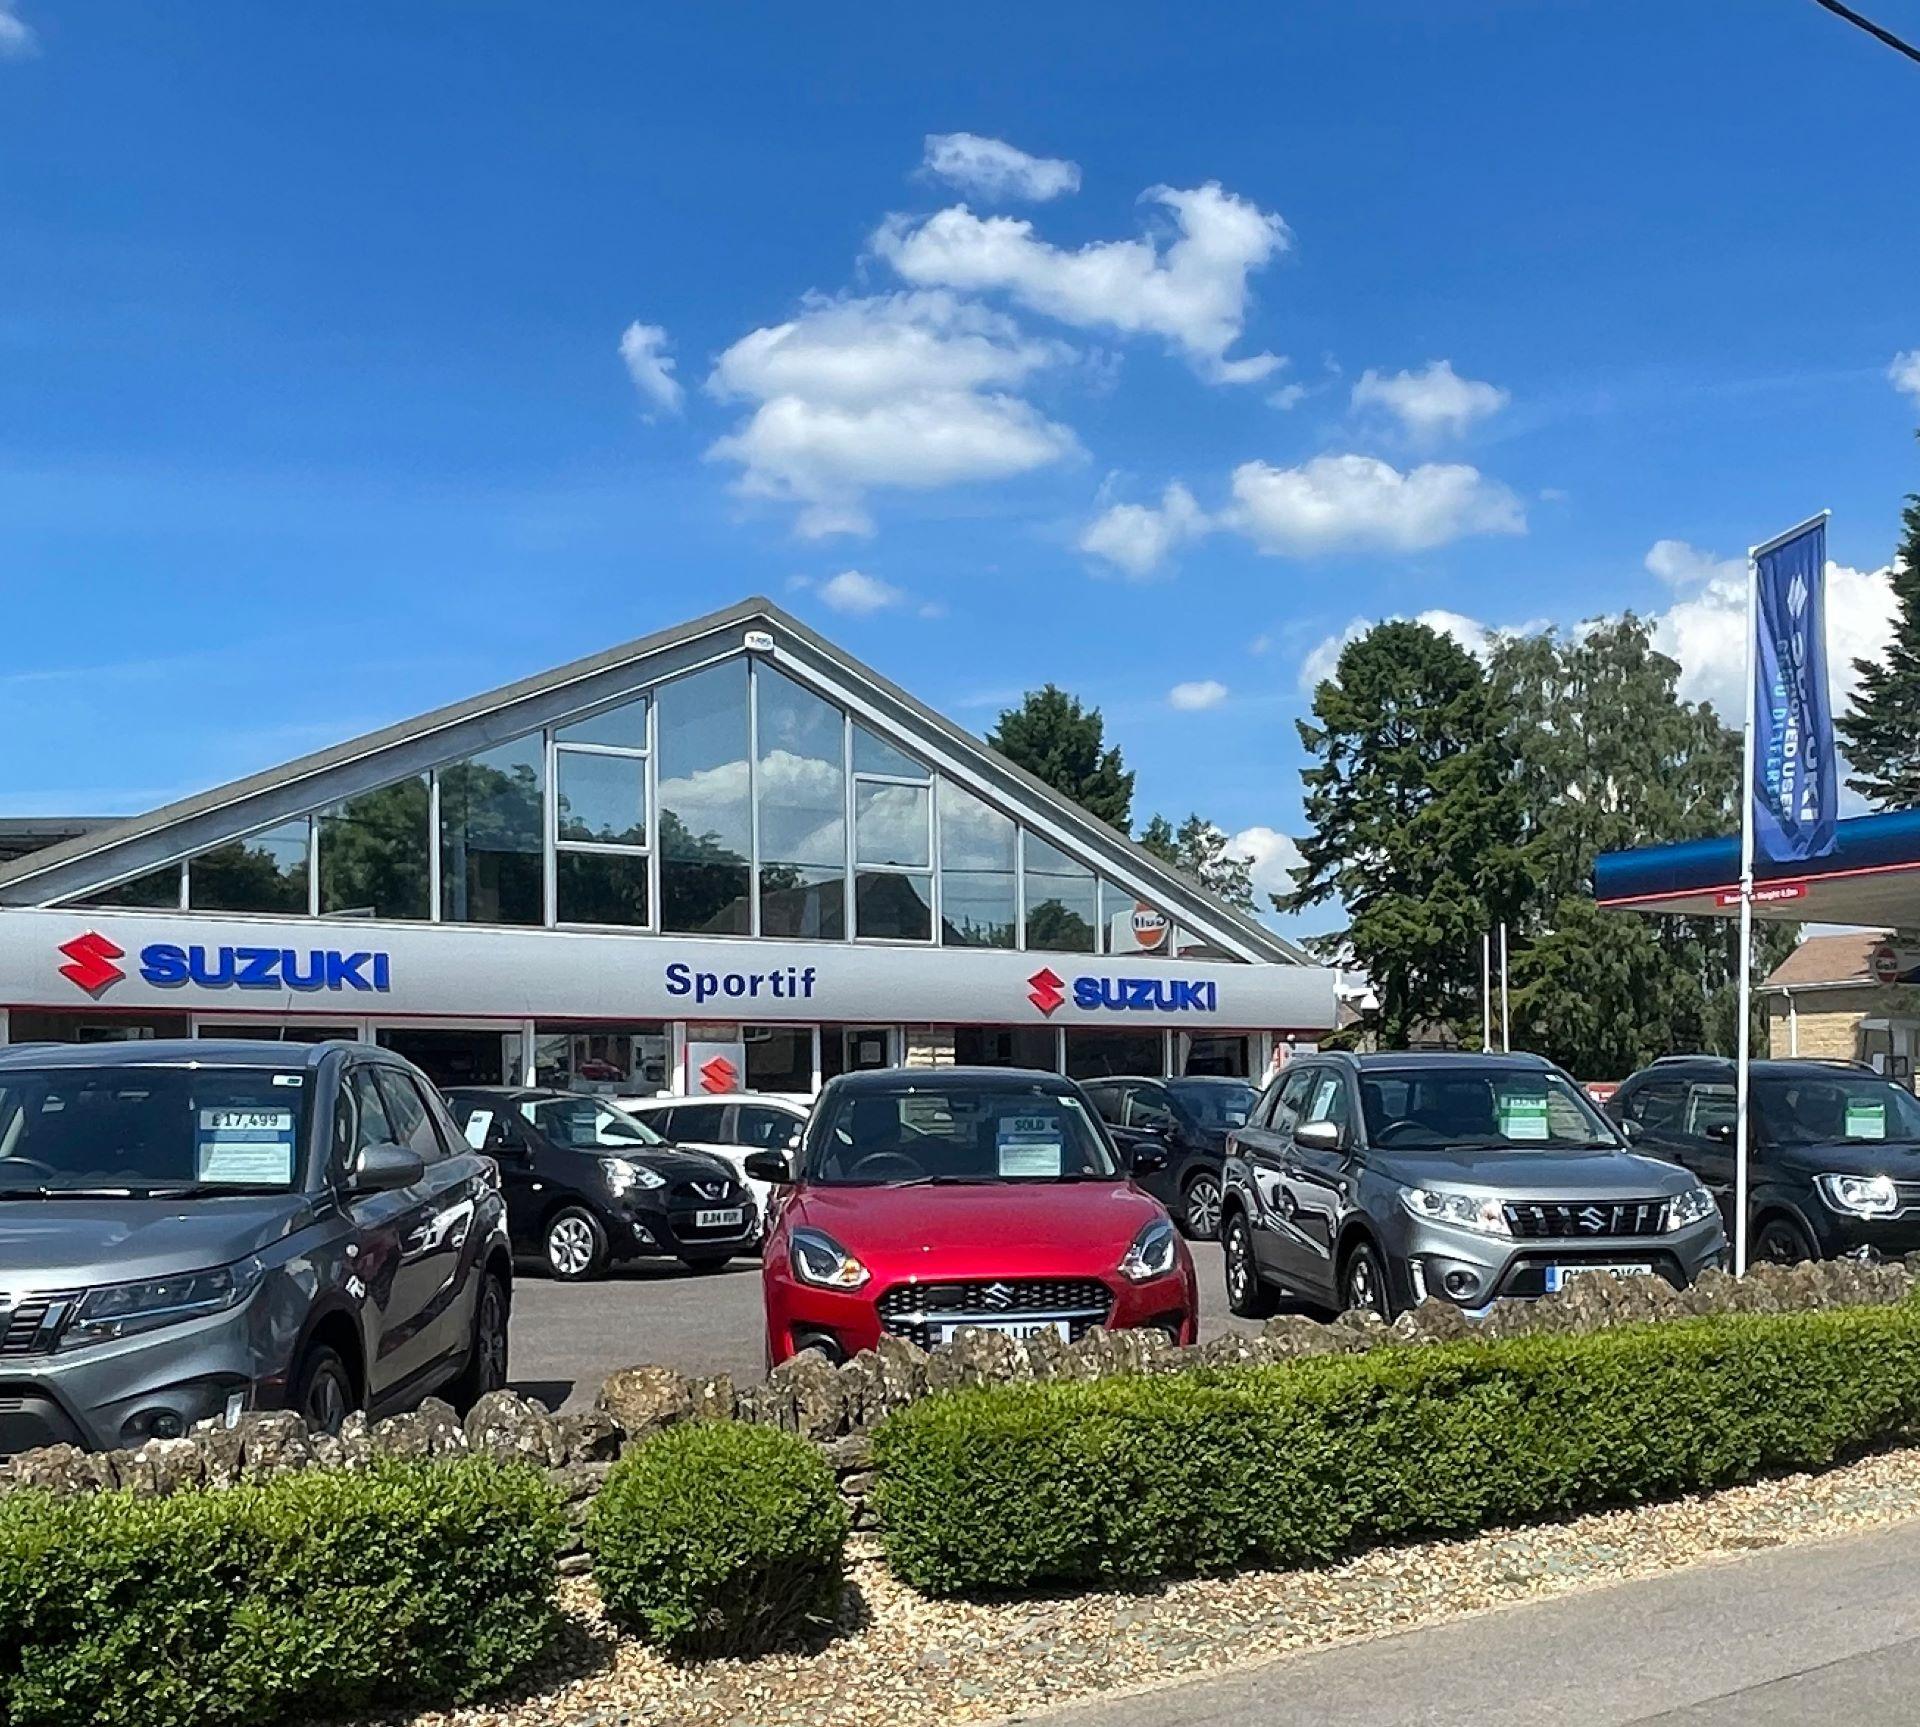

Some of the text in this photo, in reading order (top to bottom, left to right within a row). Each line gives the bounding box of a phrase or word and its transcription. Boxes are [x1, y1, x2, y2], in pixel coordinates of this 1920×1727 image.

[140, 943, 389, 992] SUZUKI
[666, 963, 816, 1004] Sportif
[1074, 977, 1216, 1012] SUZUKI
[1014, 1119, 1045, 1132] SOLD
